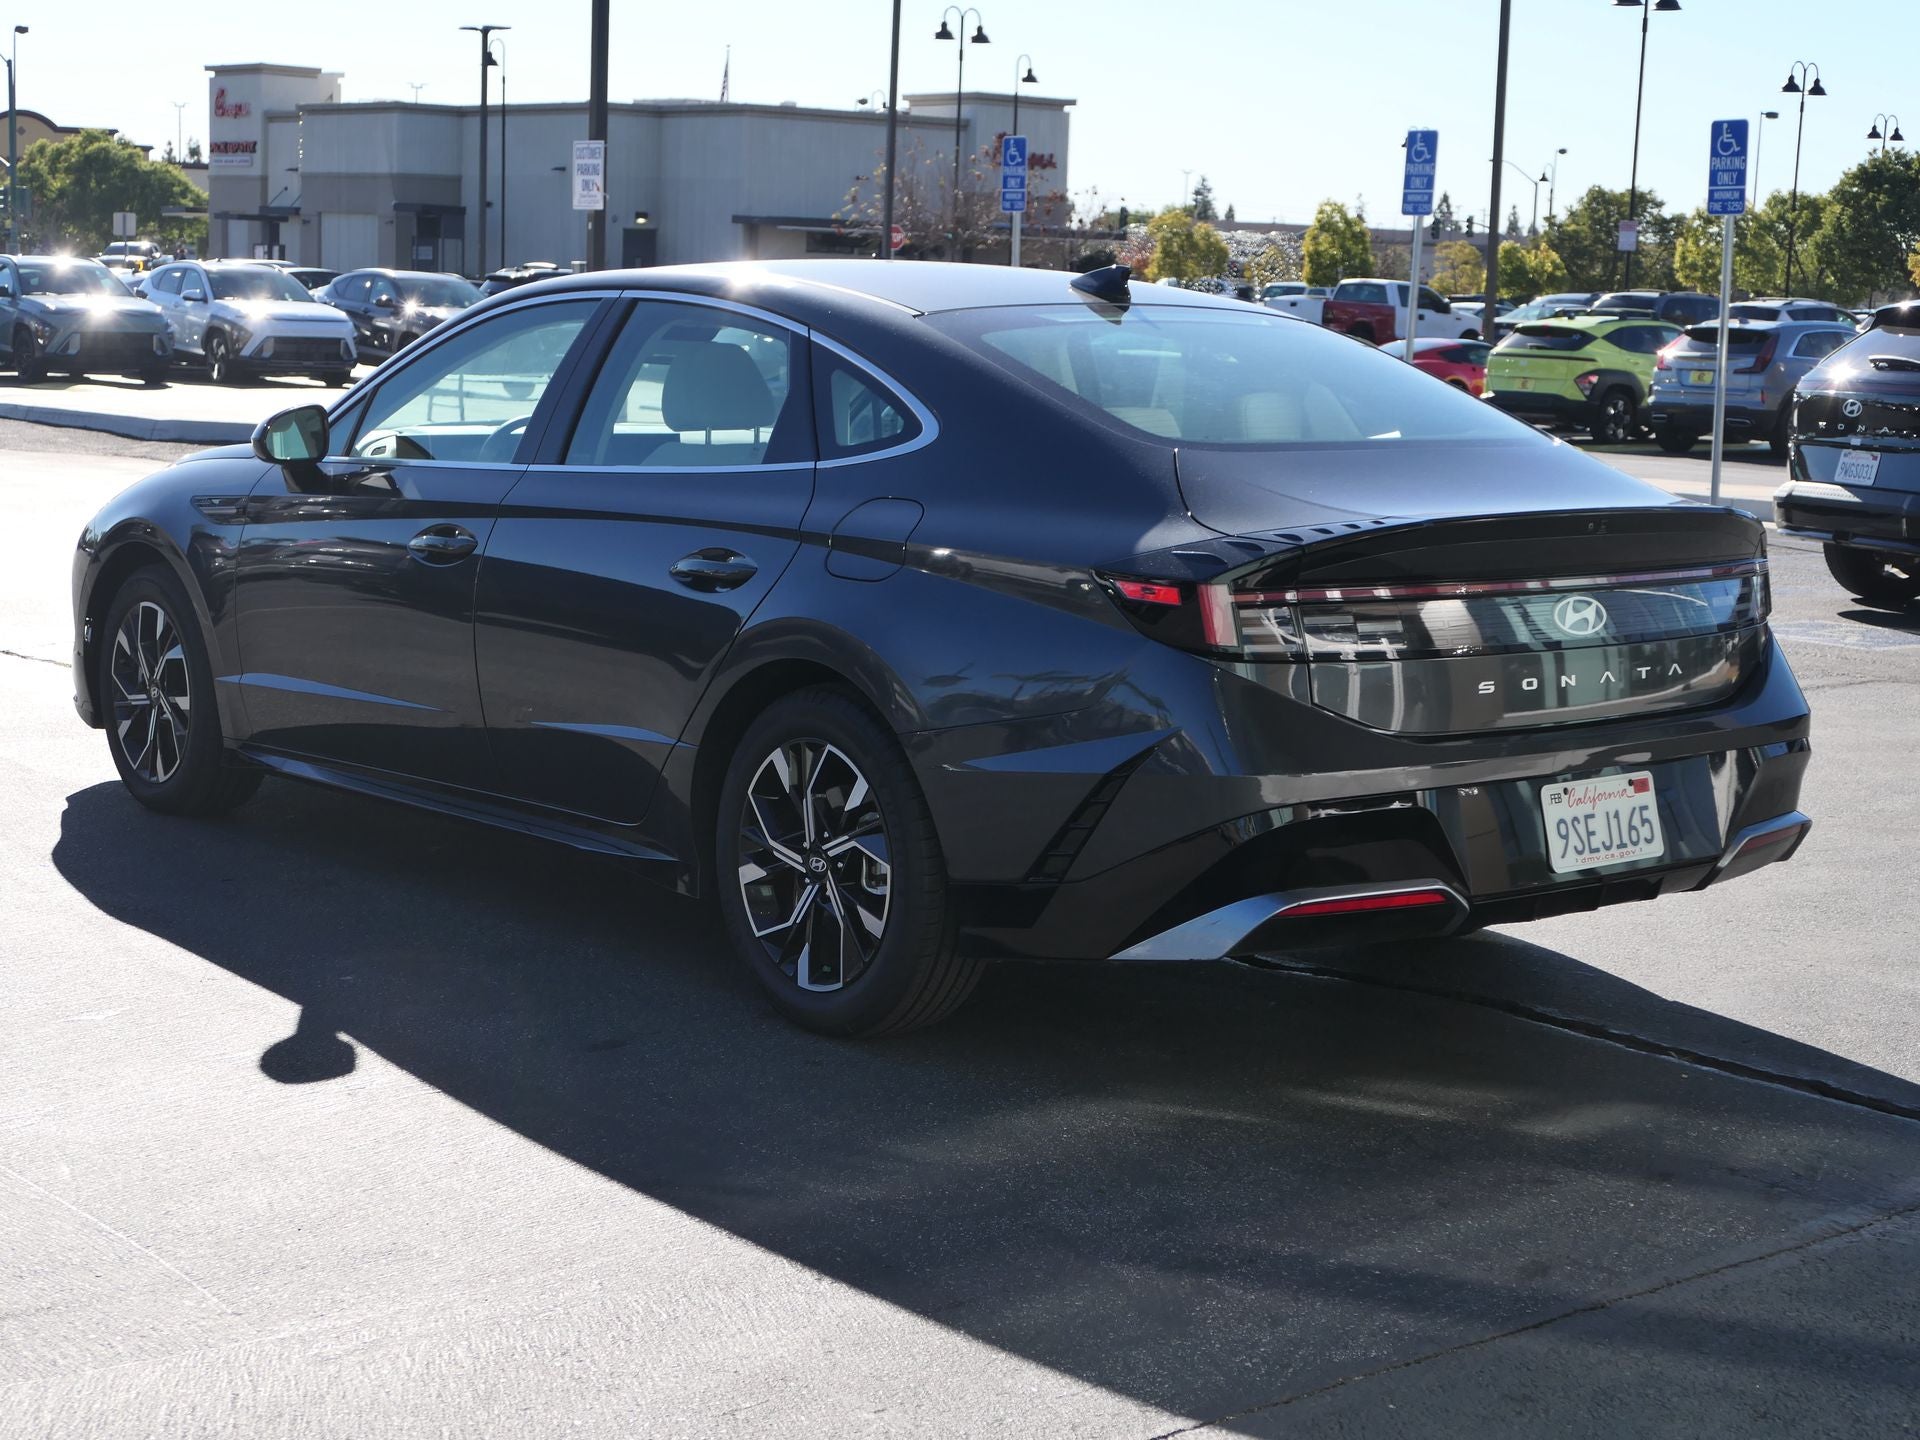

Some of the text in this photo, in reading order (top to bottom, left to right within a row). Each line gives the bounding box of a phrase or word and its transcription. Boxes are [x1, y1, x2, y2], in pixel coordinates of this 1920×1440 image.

[576, 163, 600, 176] PARKING
[1406, 163, 1435, 176] PARKING
[1711, 156, 1746, 170] PARKING
[1007, 177, 1021, 188] ONLY
[1410, 176, 1428, 188] ONLY
[1717, 171, 1738, 185] ONLY
[582, 179, 595, 191] ONLY
[1713, 190, 1740, 200] MINIMUM
[1709, 202, 1743, 212] FINE $250
[1818, 421, 1890, 433] KONA
[1478, 663, 1683, 695] SONATA
[1550, 793, 1562, 805] FEB
[1567, 784, 1635, 810] California
[1556, 805, 1655, 859] 9SEJ165
[1581, 850, 1637, 864] dmv.ca.gov
